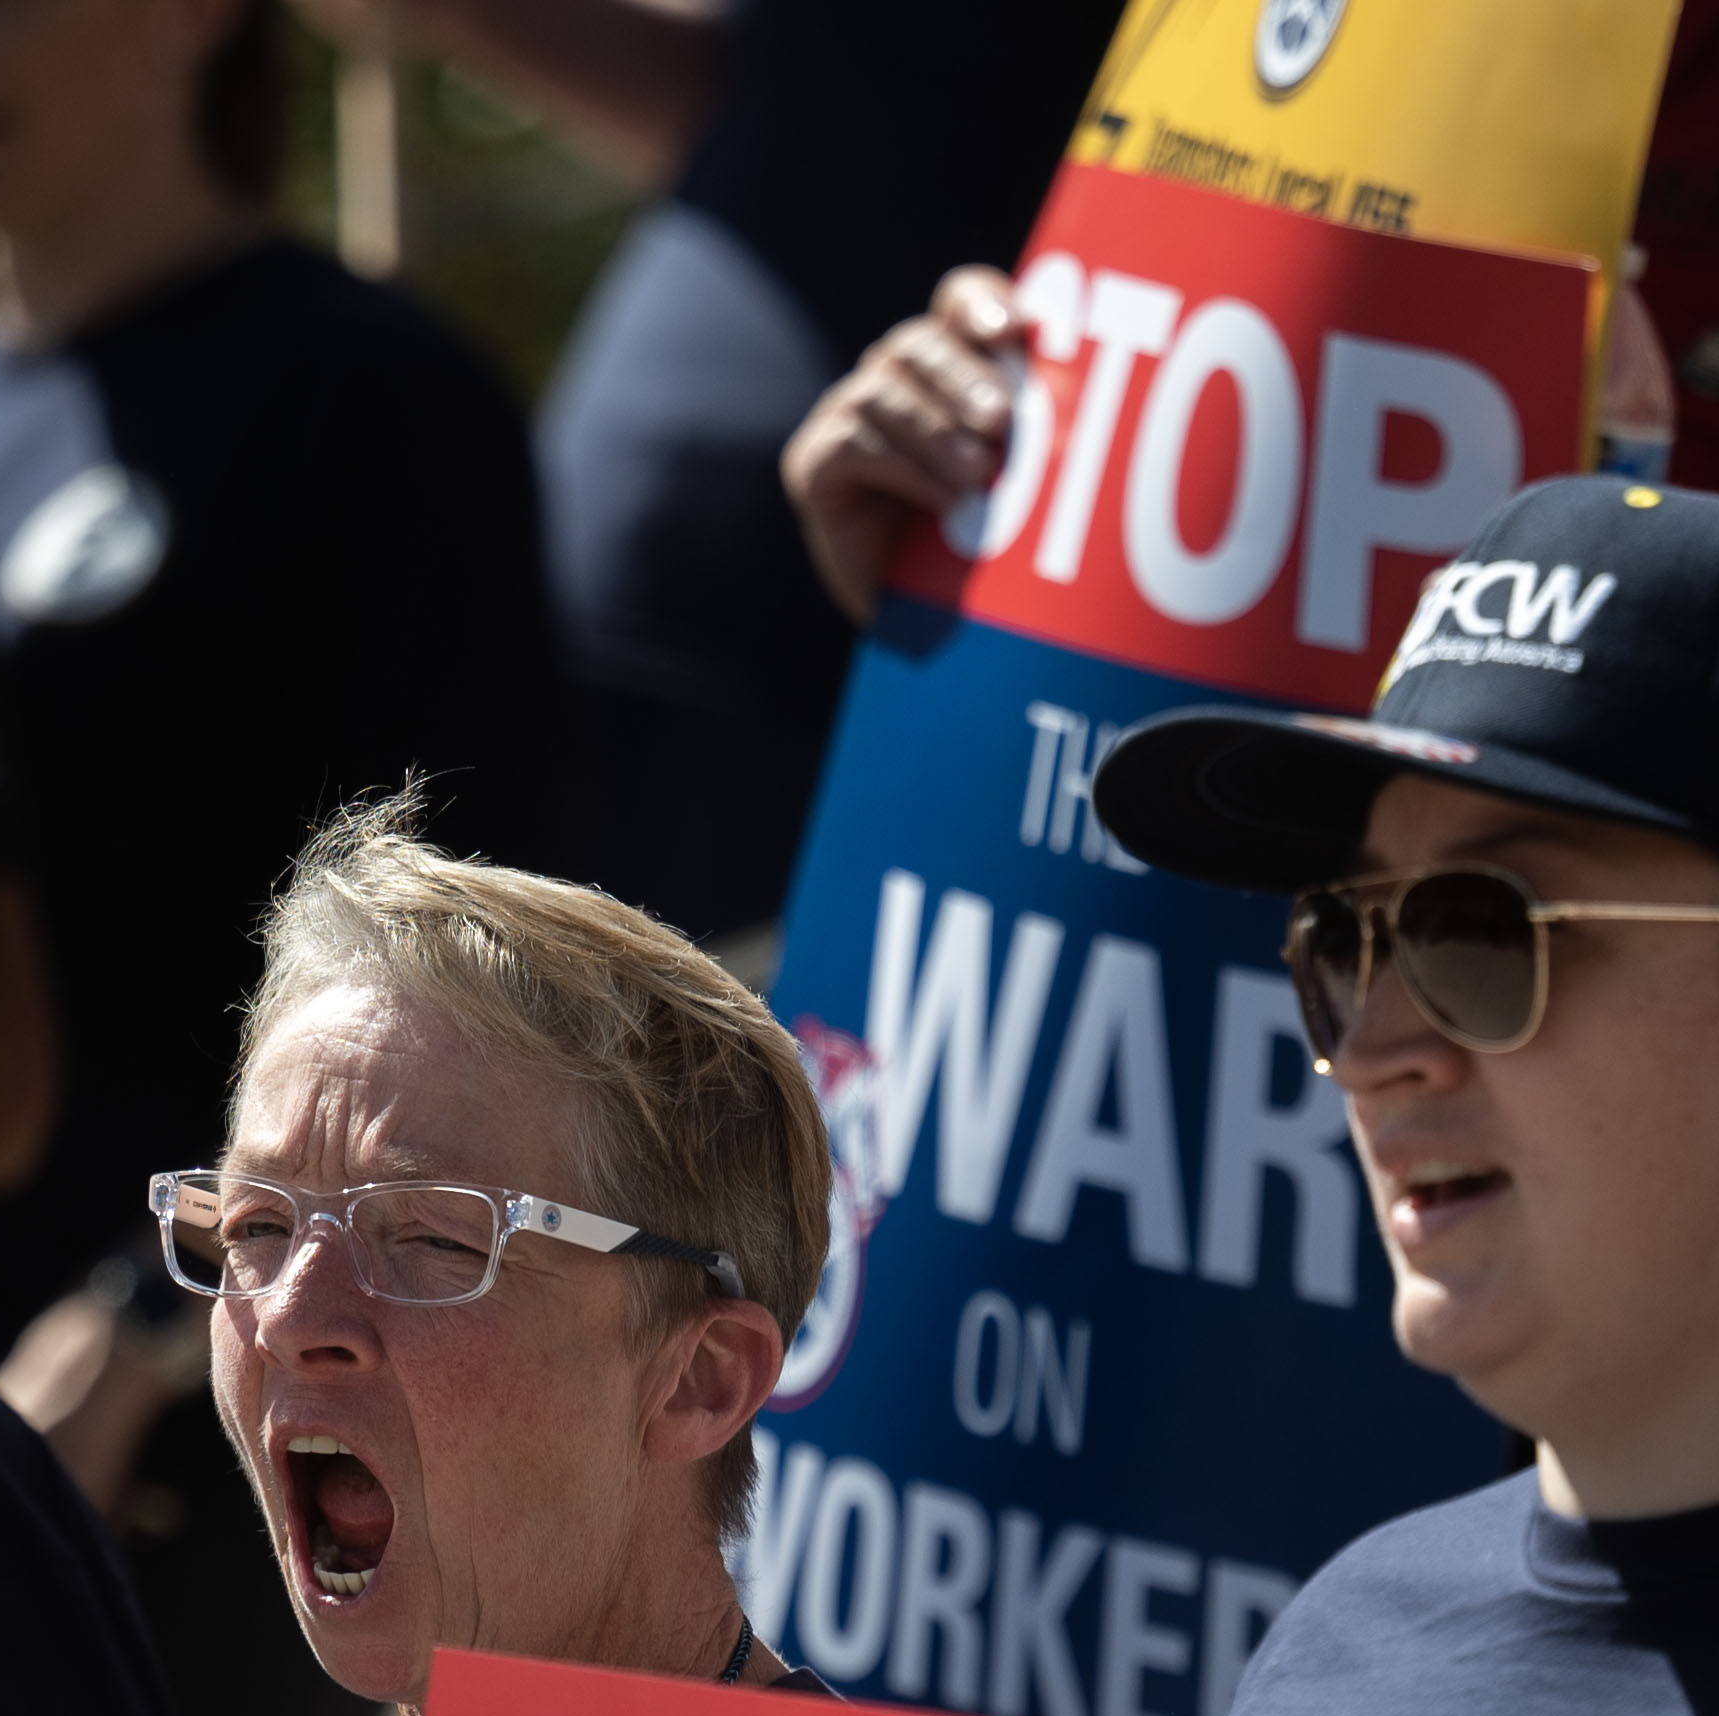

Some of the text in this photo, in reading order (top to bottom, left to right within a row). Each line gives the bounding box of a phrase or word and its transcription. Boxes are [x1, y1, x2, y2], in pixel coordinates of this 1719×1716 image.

[938, 250, 1523, 655] STOP
[1392, 558, 1618, 650] FCW
[1019, 699, 1152, 876] TH
[866, 866, 1357, 1308] WAR
[952, 1291, 1091, 1456] ON
